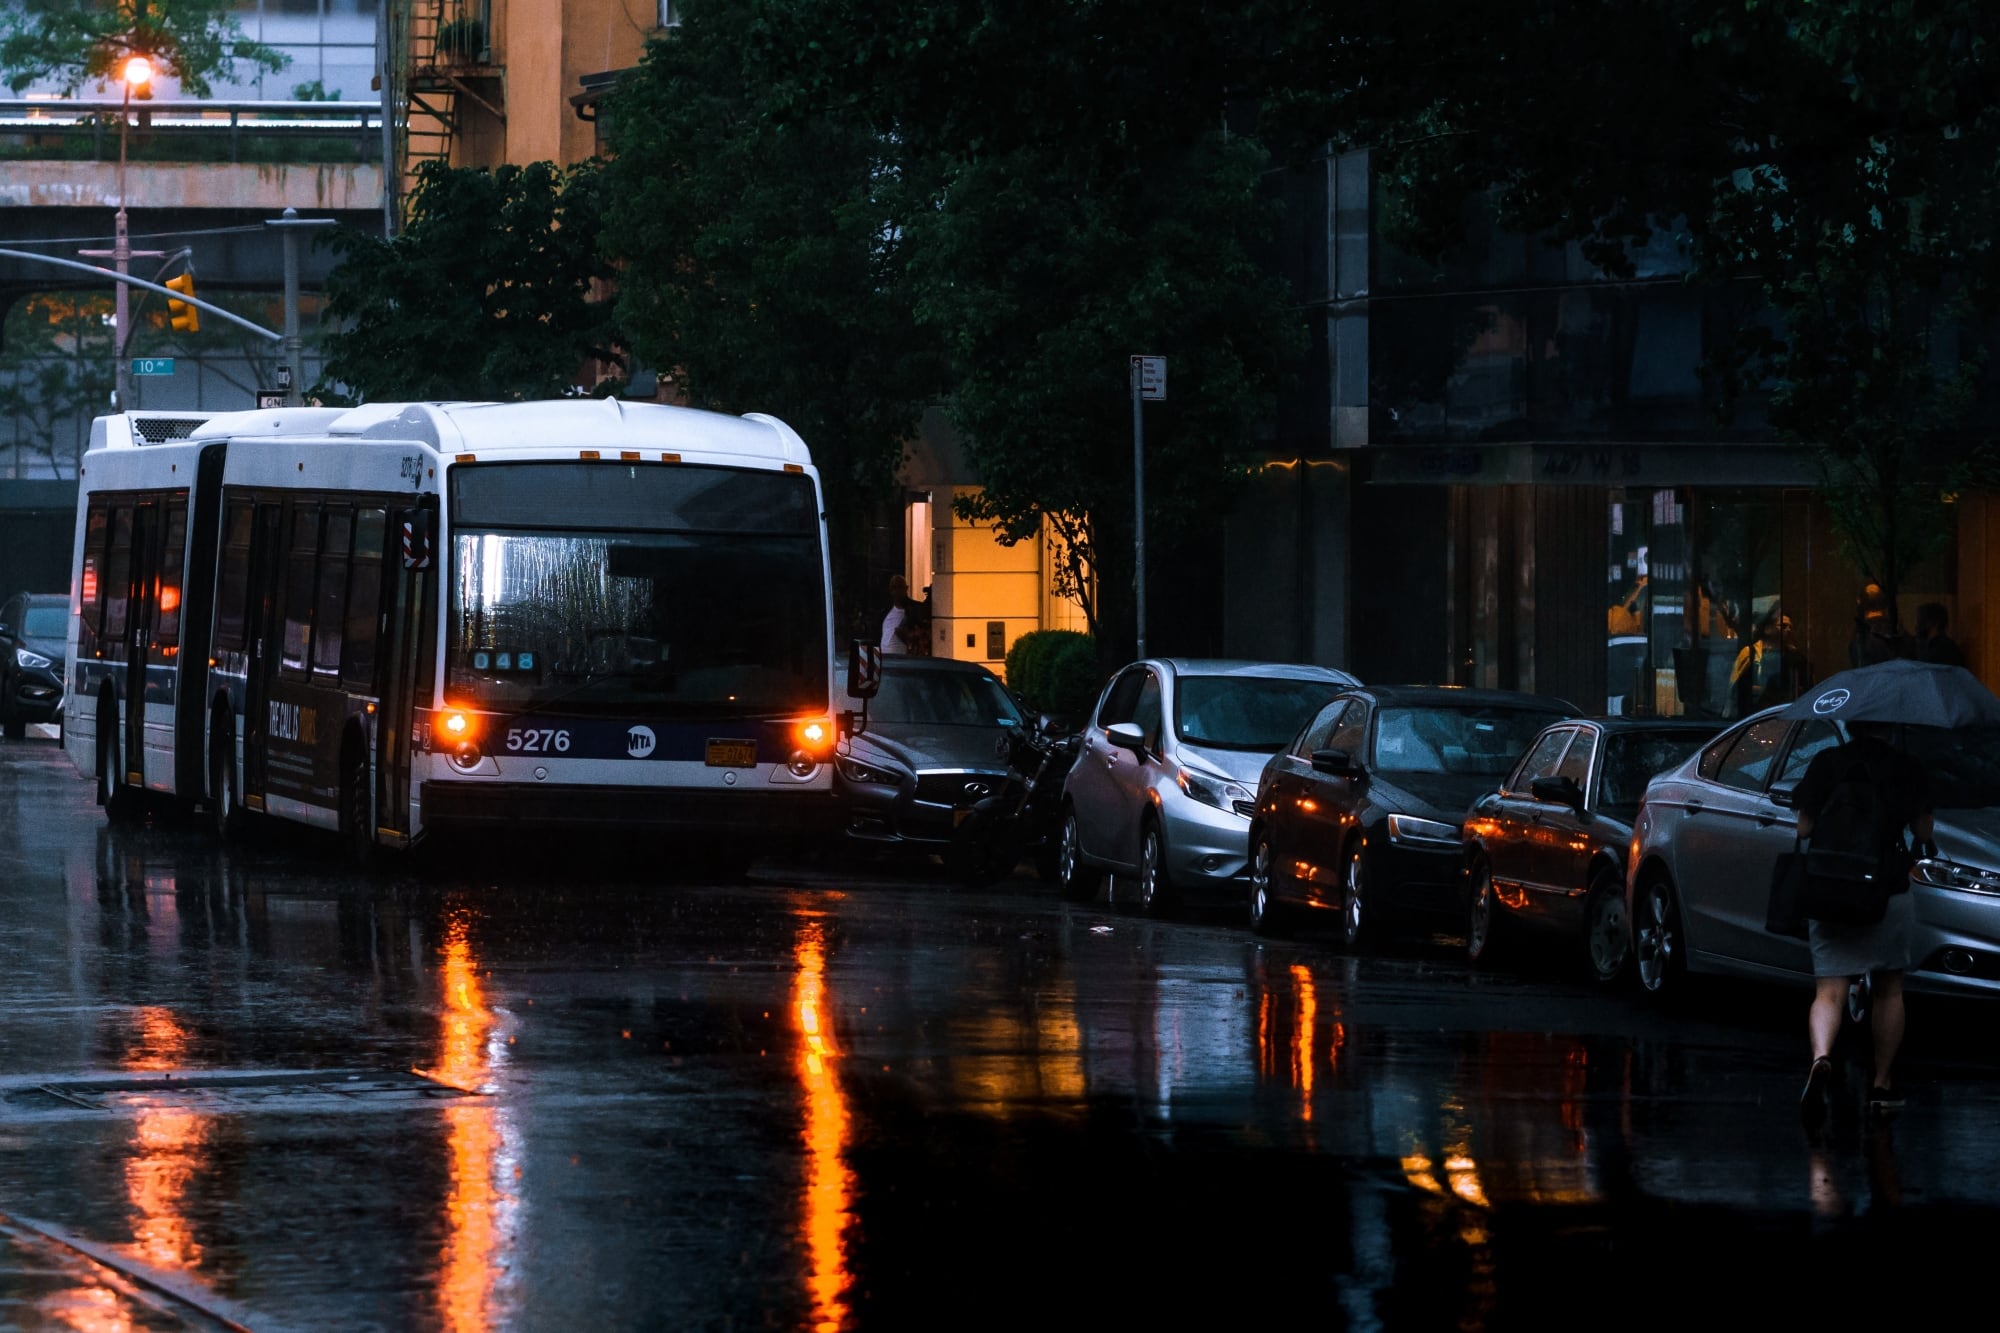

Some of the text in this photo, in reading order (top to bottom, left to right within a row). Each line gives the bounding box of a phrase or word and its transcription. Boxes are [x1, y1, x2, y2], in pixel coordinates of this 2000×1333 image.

[140, 360, 154, 373] 10
[266, 397, 288, 408] ONE
[269, 700, 280, 736] THE
[280, 702, 292, 740] CALL
[292, 704, 300, 742] IS
[506, 728, 571, 752] 5276
[627, 732, 652, 751] MTA
